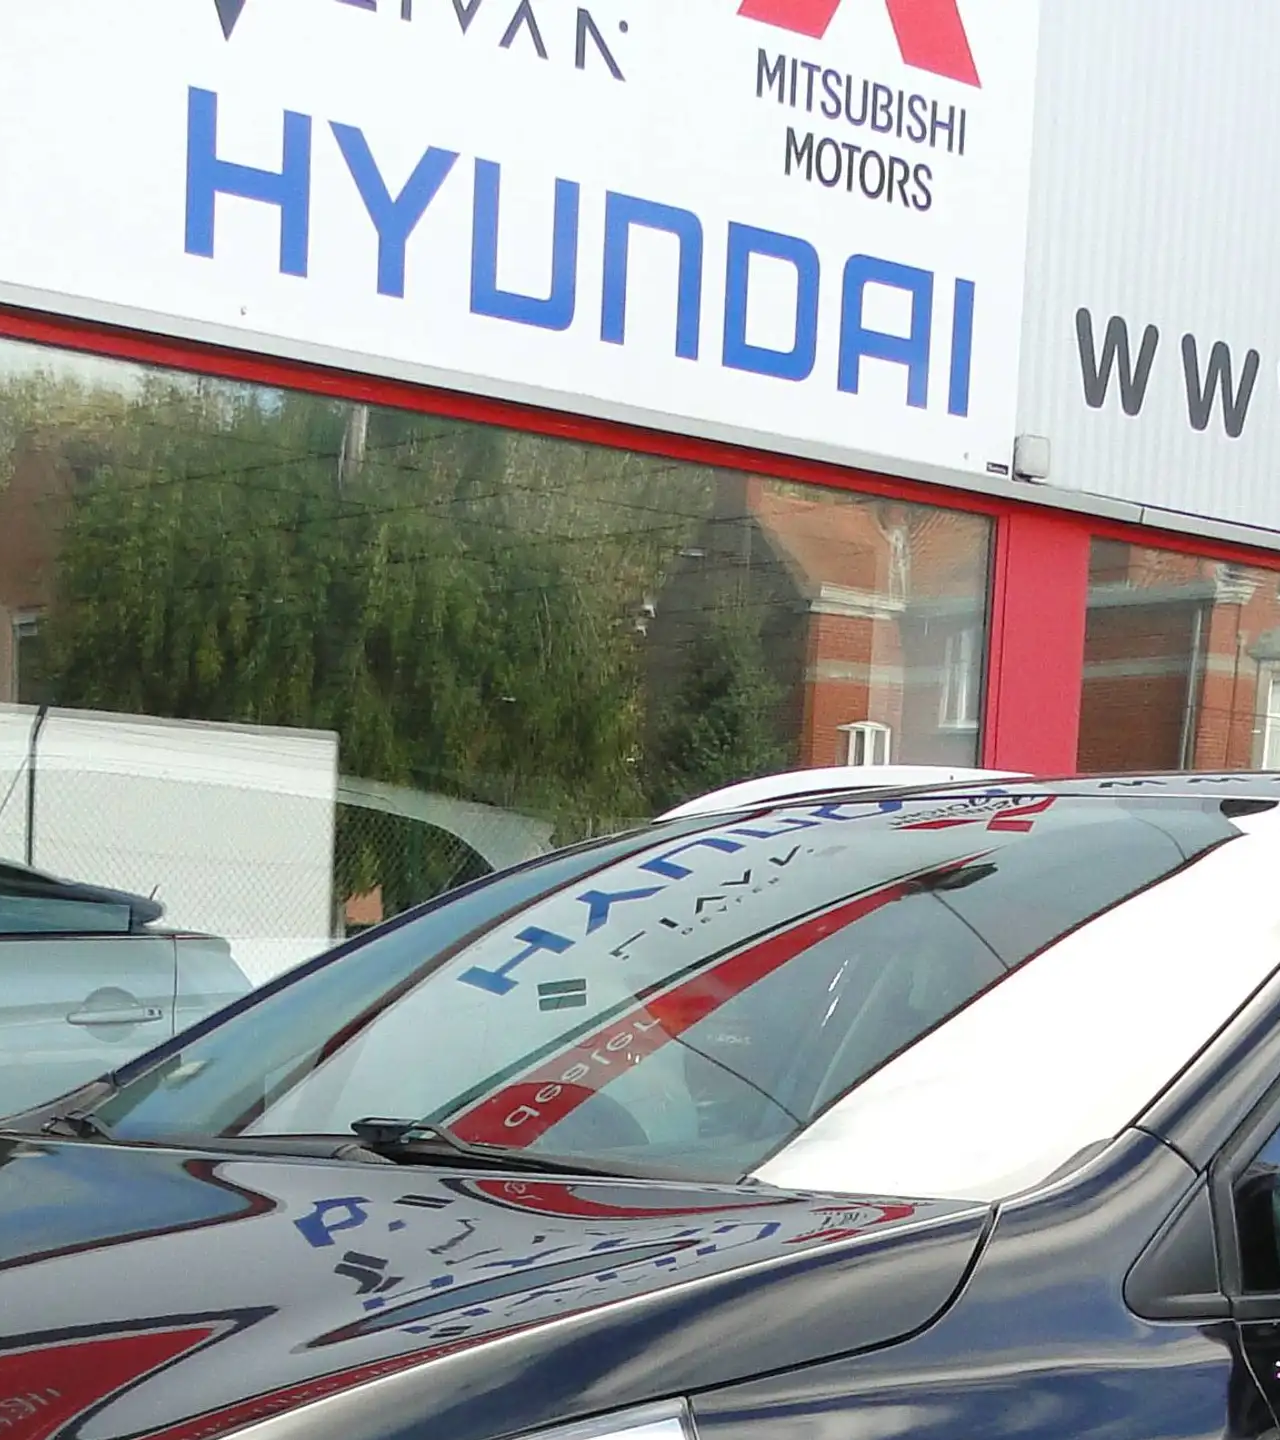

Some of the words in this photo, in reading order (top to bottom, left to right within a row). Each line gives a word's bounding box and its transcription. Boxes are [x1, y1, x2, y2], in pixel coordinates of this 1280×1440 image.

[755, 47, 967, 156] MITSUBISHI
[783, 125, 934, 213] MOTORS
[183, 84, 977, 419] HYUNDAI
